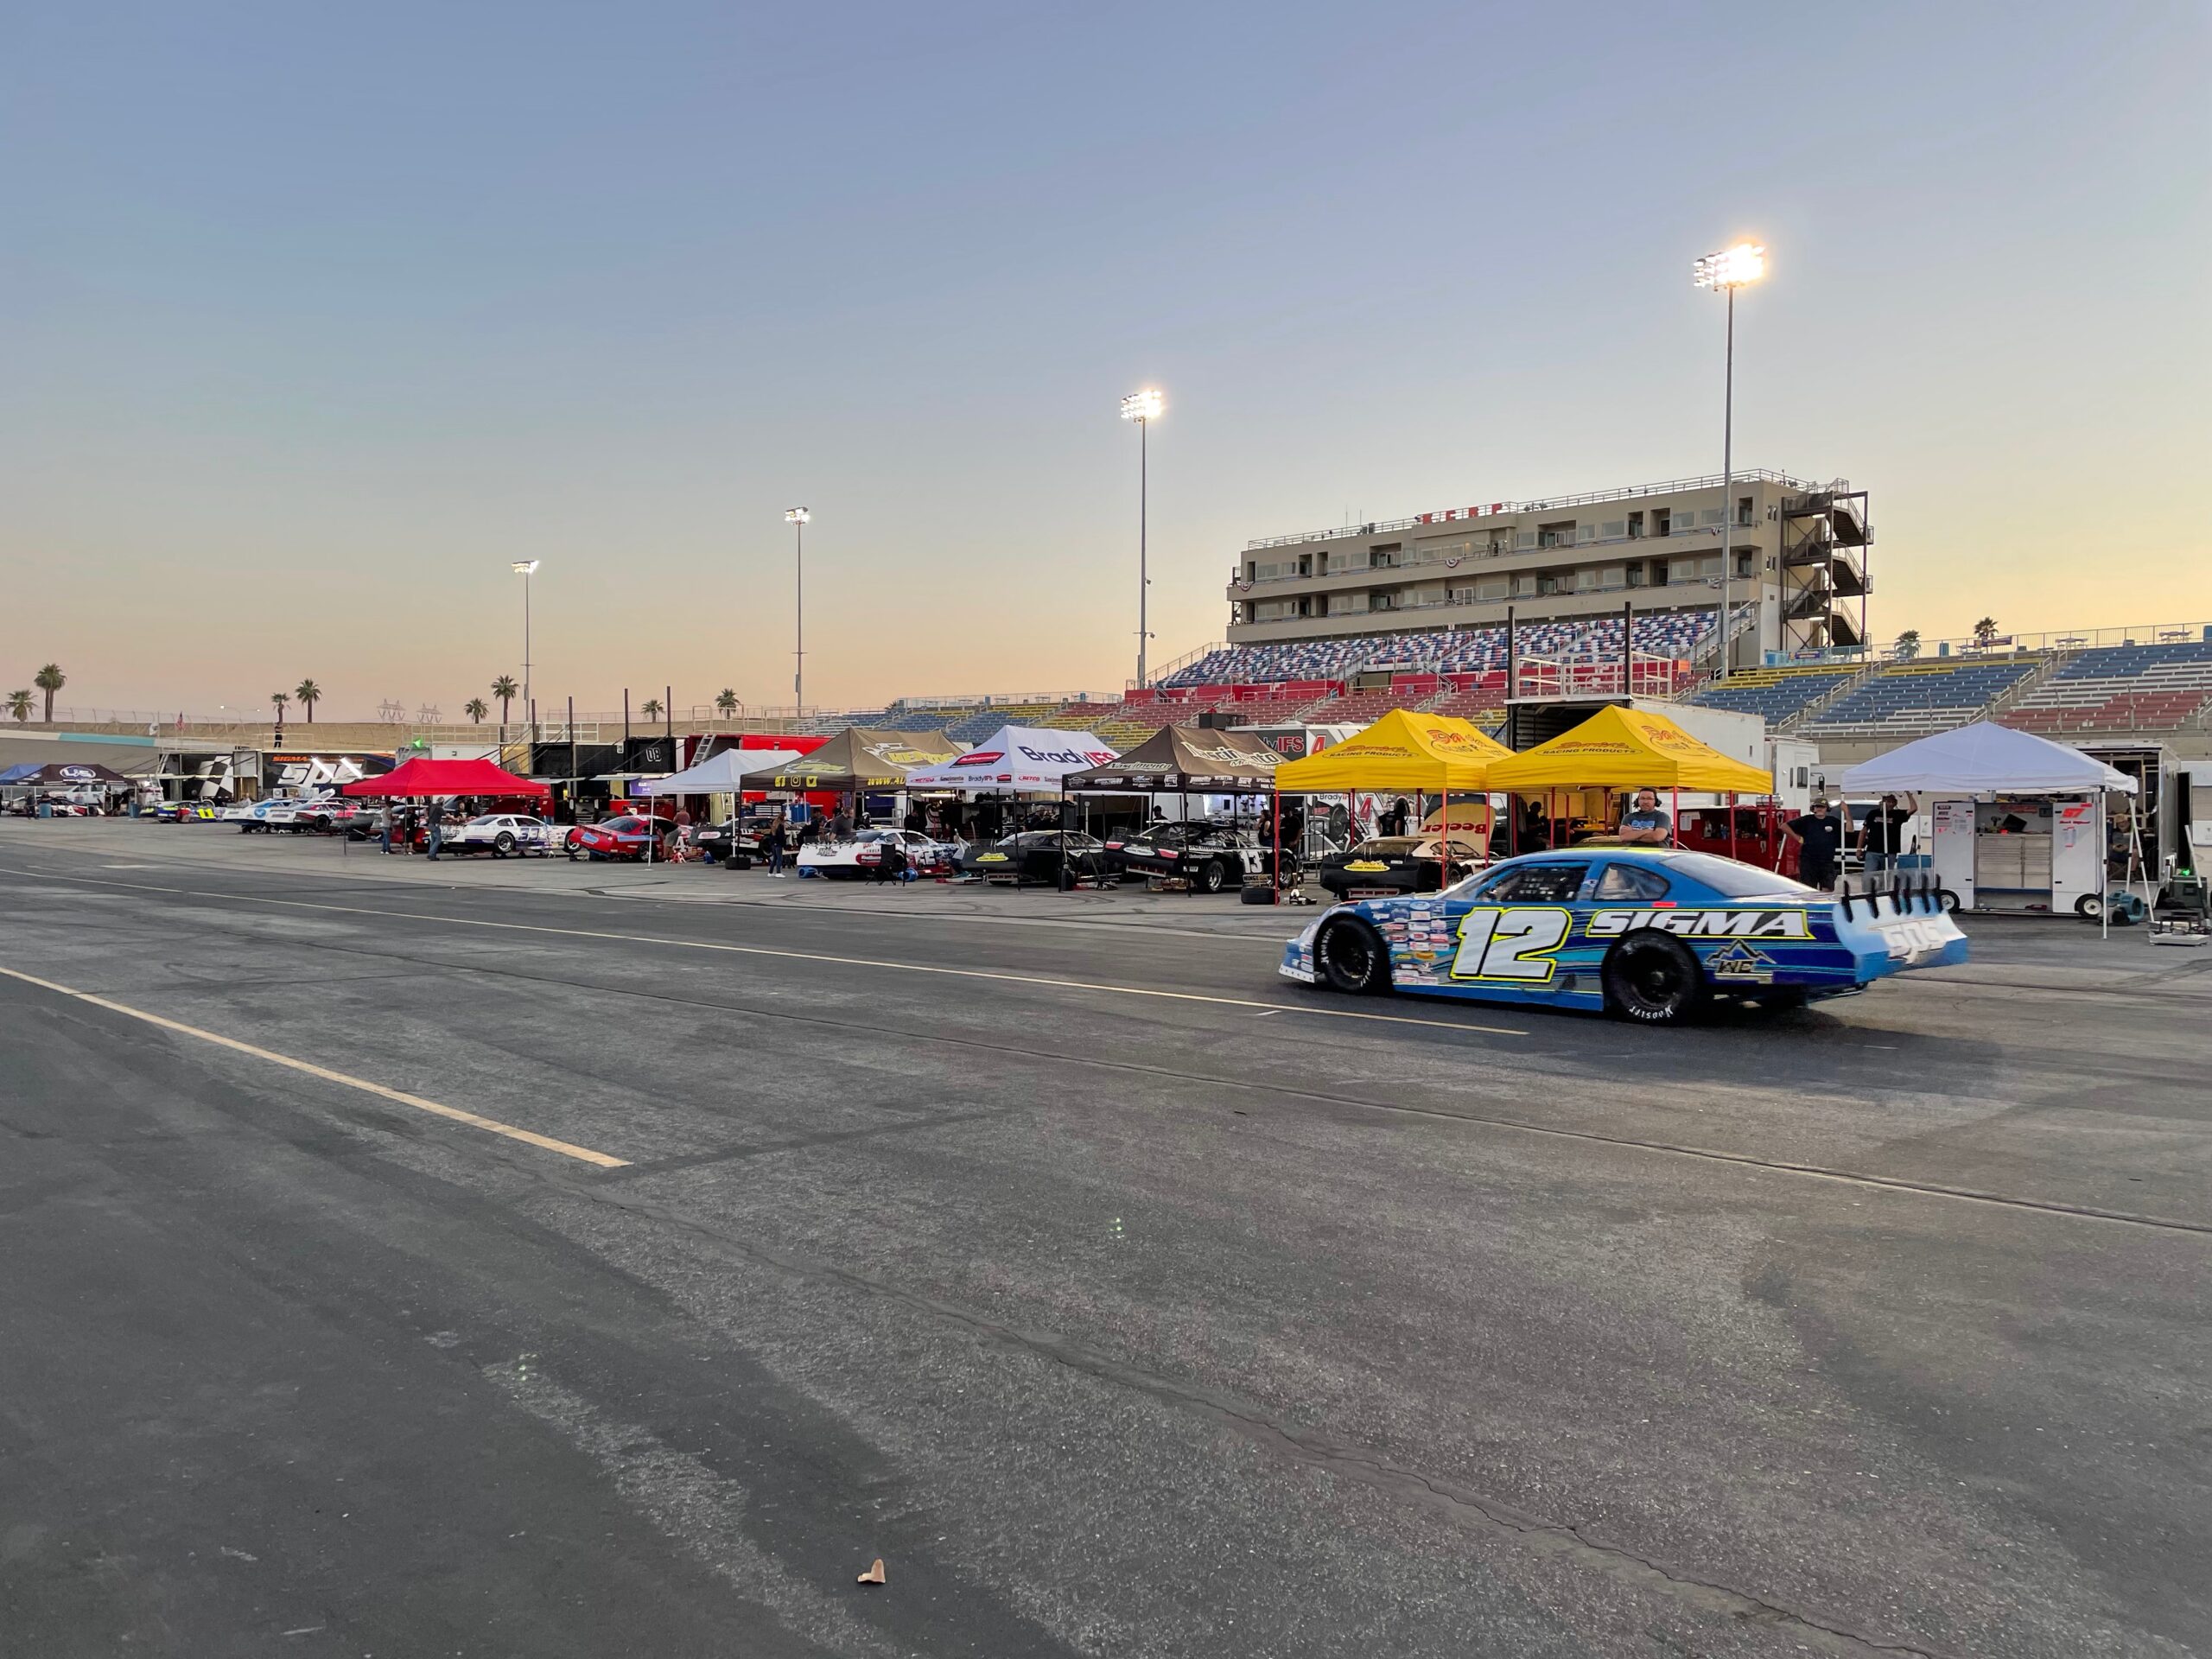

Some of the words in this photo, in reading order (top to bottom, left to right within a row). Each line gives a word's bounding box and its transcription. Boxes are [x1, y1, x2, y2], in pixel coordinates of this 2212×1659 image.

[1239, 850, 1263, 874] 13
[1590, 911, 1807, 936] SIGMA
[1452, 908, 1572, 981] 12
